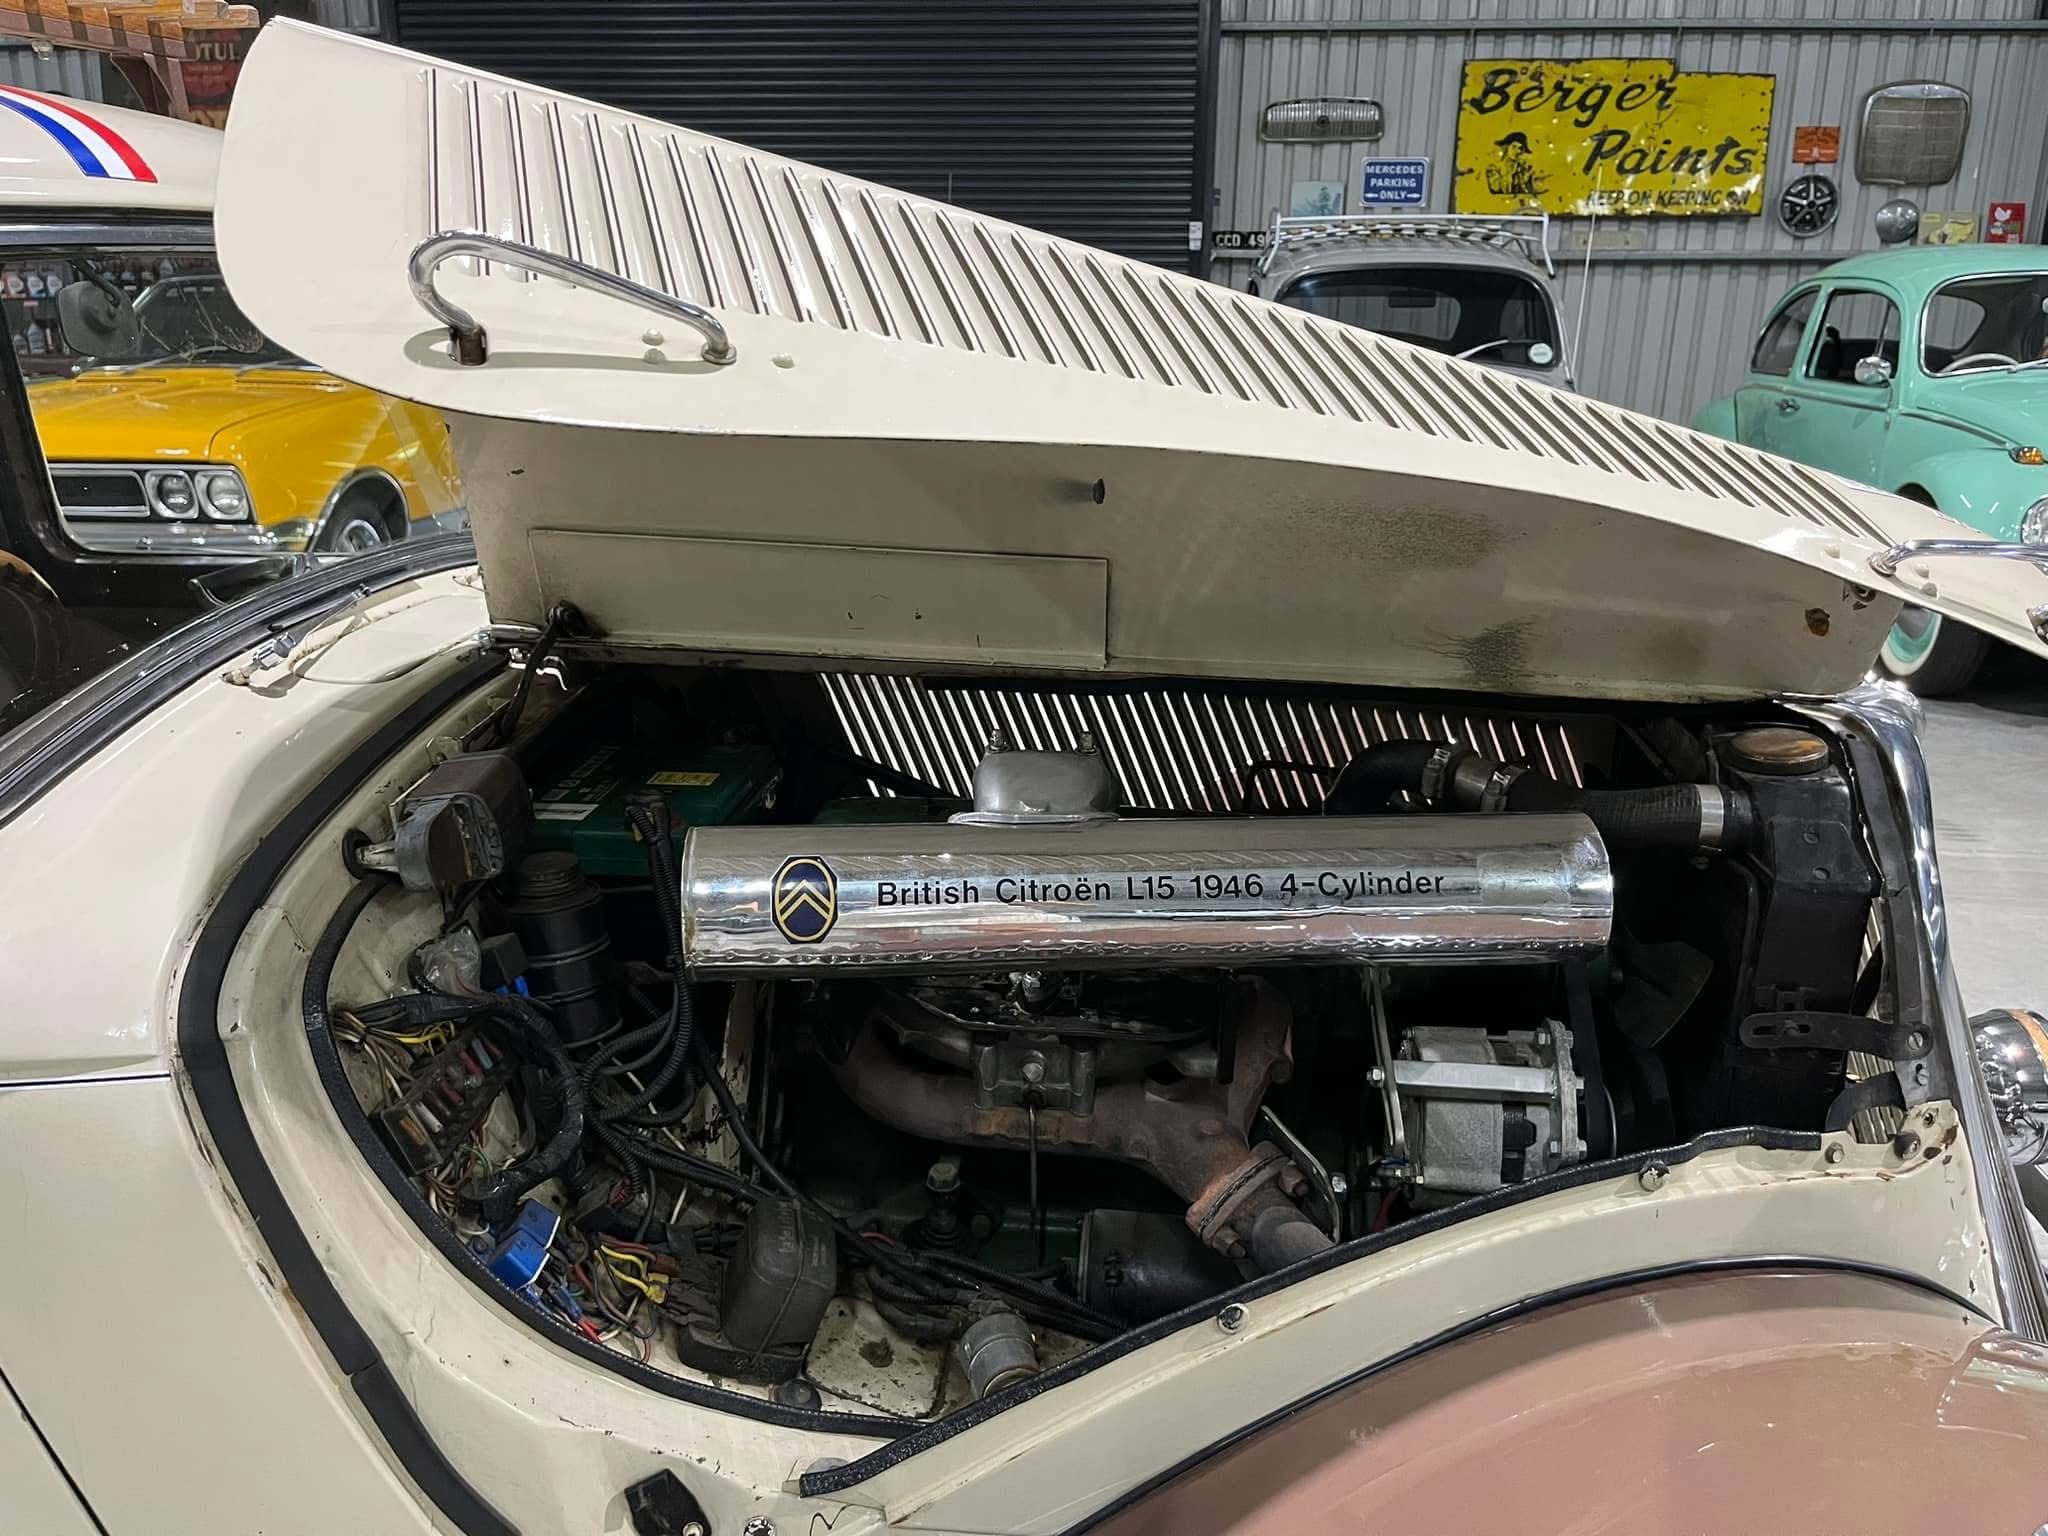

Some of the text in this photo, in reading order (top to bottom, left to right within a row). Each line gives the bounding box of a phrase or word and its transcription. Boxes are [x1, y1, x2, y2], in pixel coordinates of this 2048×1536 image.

[194, 42, 240, 61] TUL
[1471, 67, 1678, 128] Berger
[1582, 129, 1757, 176] Paints
[1366, 165, 1424, 175] MERCEDES
[1370, 177, 1417, 188] PARKING
[1379, 190, 1407, 200] ONLY
[1585, 189, 1750, 207] KEEP ON KEEPING ON
[877, 870, 1445, 906] British Citroën L15 1946 4-Cylinder
